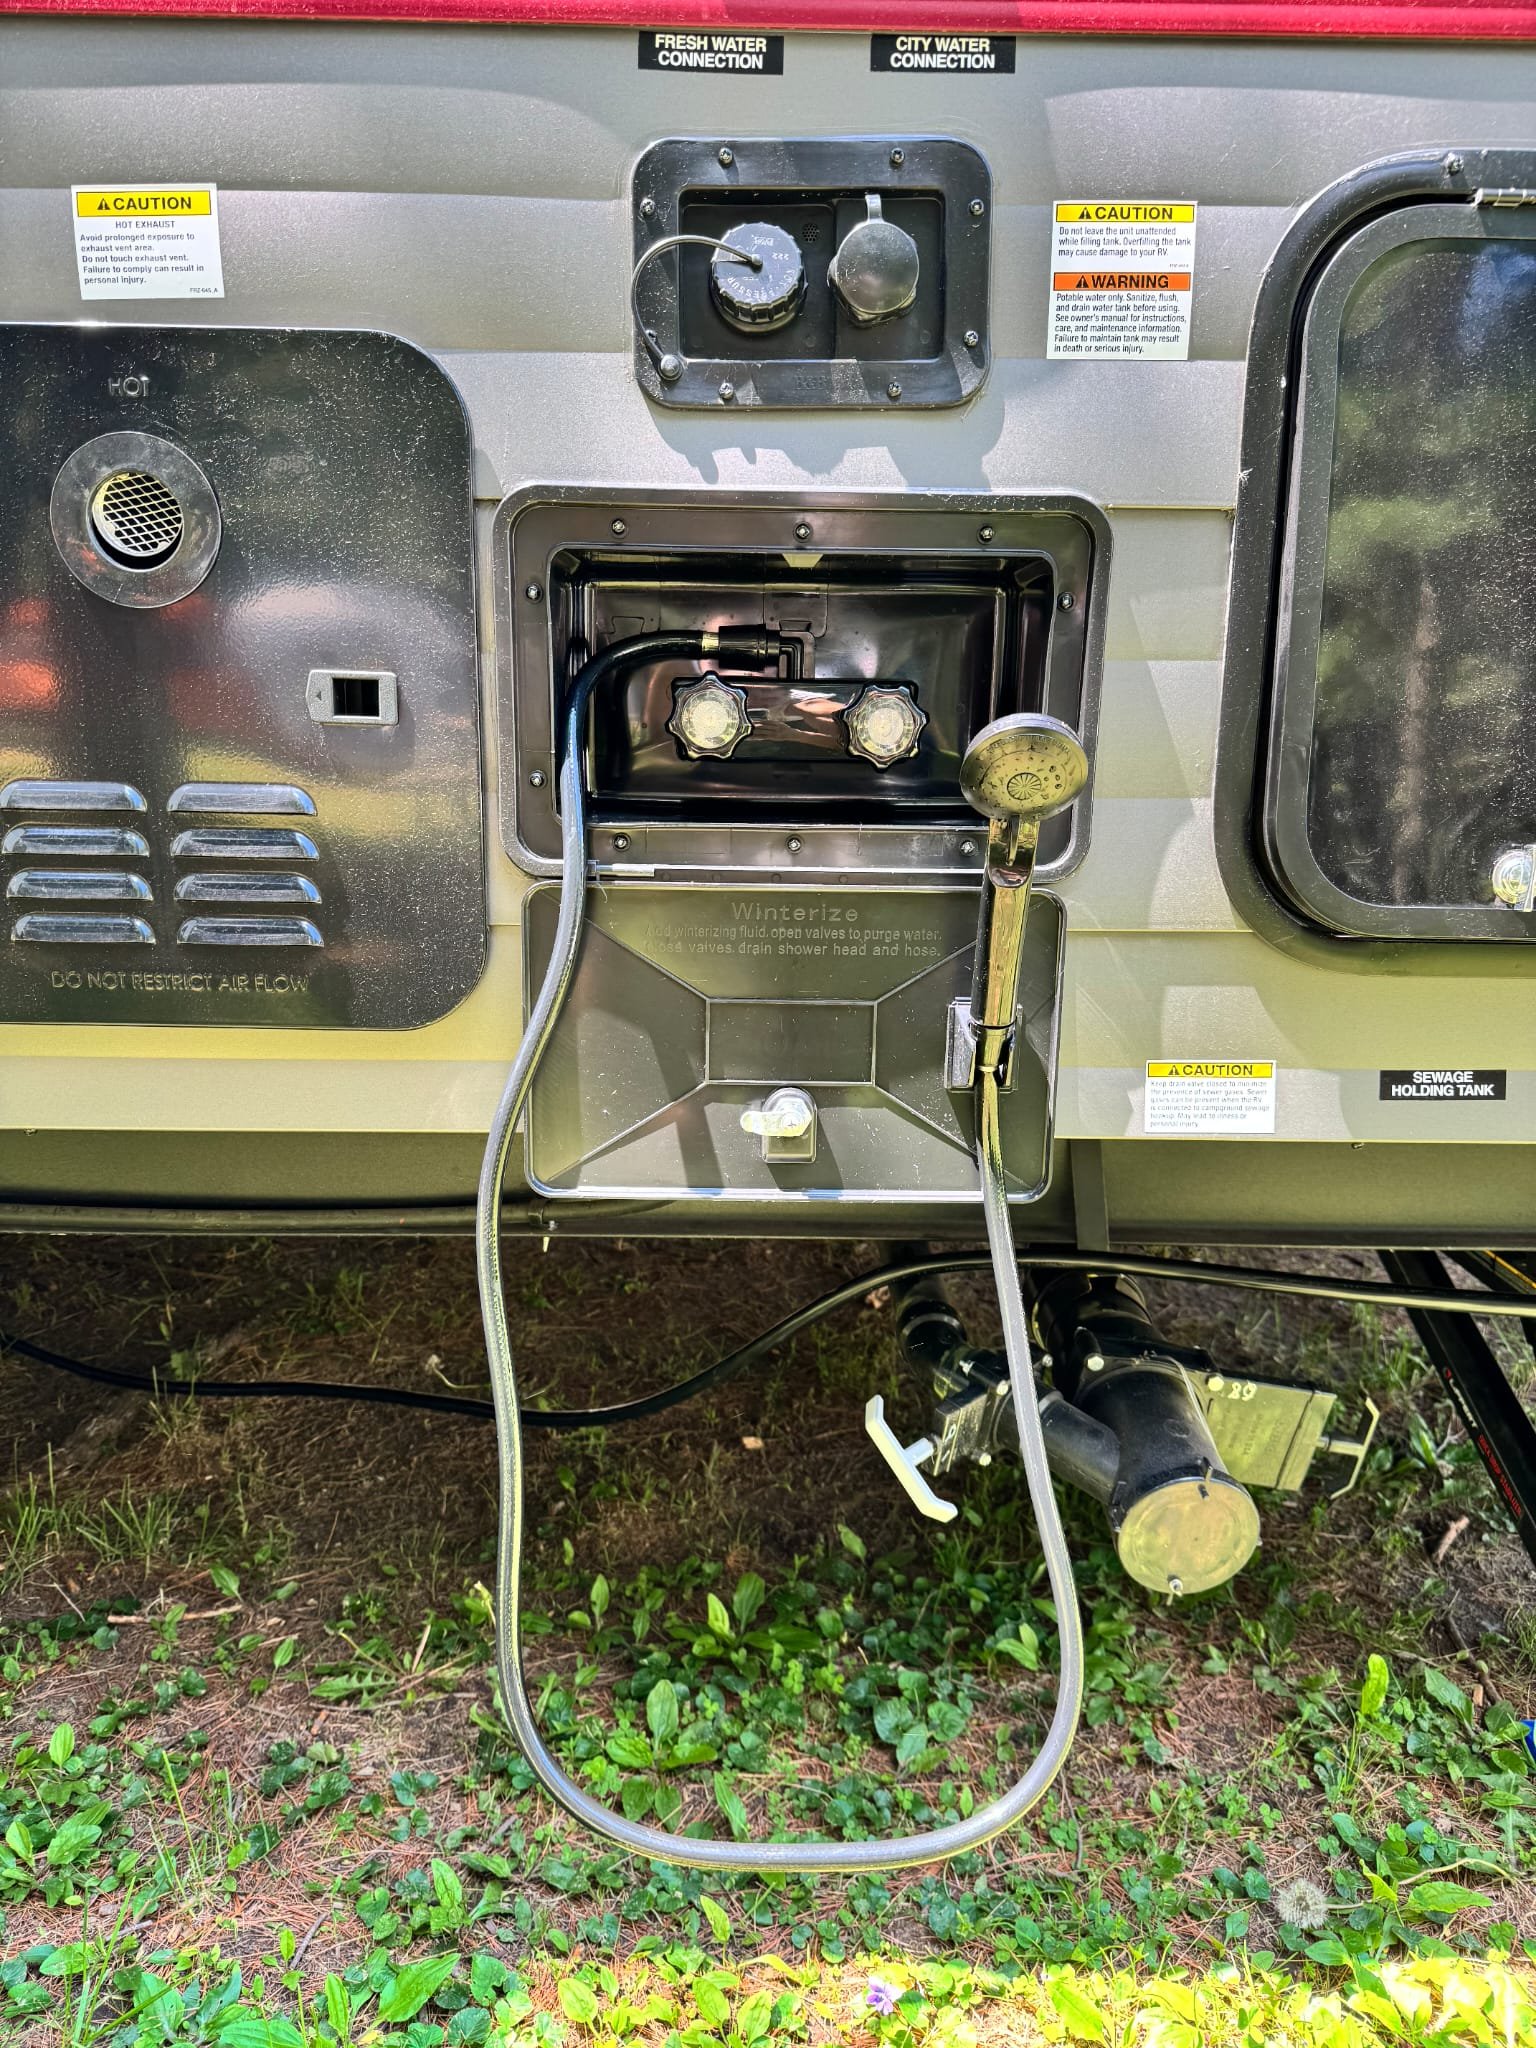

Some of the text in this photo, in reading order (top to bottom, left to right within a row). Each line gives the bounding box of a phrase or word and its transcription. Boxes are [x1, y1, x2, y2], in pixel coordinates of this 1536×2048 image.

[655, 34, 766, 52] FRESH WATER
[896, 37, 990, 53] CITY WATER
[658, 52, 763, 69] CONNECTION
[890, 54, 995, 69] CONNECTION
[113, 197, 191, 210] CAUTION
[1095, 207, 1172, 219] CAUTION
[116, 221, 132, 229] HOT
[1059, 227, 1176, 235] Do not leave the unit unattended
[105, 234, 145, 243] prolonged
[148, 234, 184, 242] exposure
[1059, 237, 1191, 247] while filling tank. Overfilling the tank
[1059, 249, 1073, 258] may
[1100, 248, 1128, 257] damage
[1140, 249, 1155, 258] your
[123, 265, 151, 274] comply
[85, 276, 146, 285] personal injury.
[1092, 275, 1169, 288] WARNING
[1057, 293, 1083, 301] Potable
[1108, 293, 1124, 303] only.
[1126, 293, 1157, 303] Sanitize,
[1159, 293, 1178, 303] flush,
[1056, 303, 1180, 313] and drain water tank before using.
[1055, 314, 1186, 323] See owner's manual for instructions,
[1055, 324, 1181, 333] care, and maintenance information.
[1054, 334, 1079, 342] Failure
[1090, 334, 1121, 342] maintain
[1124, 334, 1139, 342] tank
[1142, 335, 1156, 344] may
[1063, 344, 1082, 352] death
[1123, 345, 1144, 354] injury.
[108, 375, 149, 397] HOT
[731, 902, 859, 921] Winterize
[674, 926, 736, 939] winterizing
[771, 928, 801, 940] open
[806, 926, 845, 939] valves
[849, 928, 860, 939] to
[864, 930, 900, 942] purge
[738, 942, 771, 954] drain
[778, 942, 828, 955] shower
[833, 943, 866, 955] head
[873, 944, 898, 955] and
[905, 943, 941, 956] hose.
[51, 971, 308, 993] DO NOT RESTRICT AIR FLOW
[1183, 1065, 1252, 1075] CAUTION
[1413, 1071, 1473, 1083] SEWAGE
[1392, 1084, 1494, 1096] HOLDING TANK
